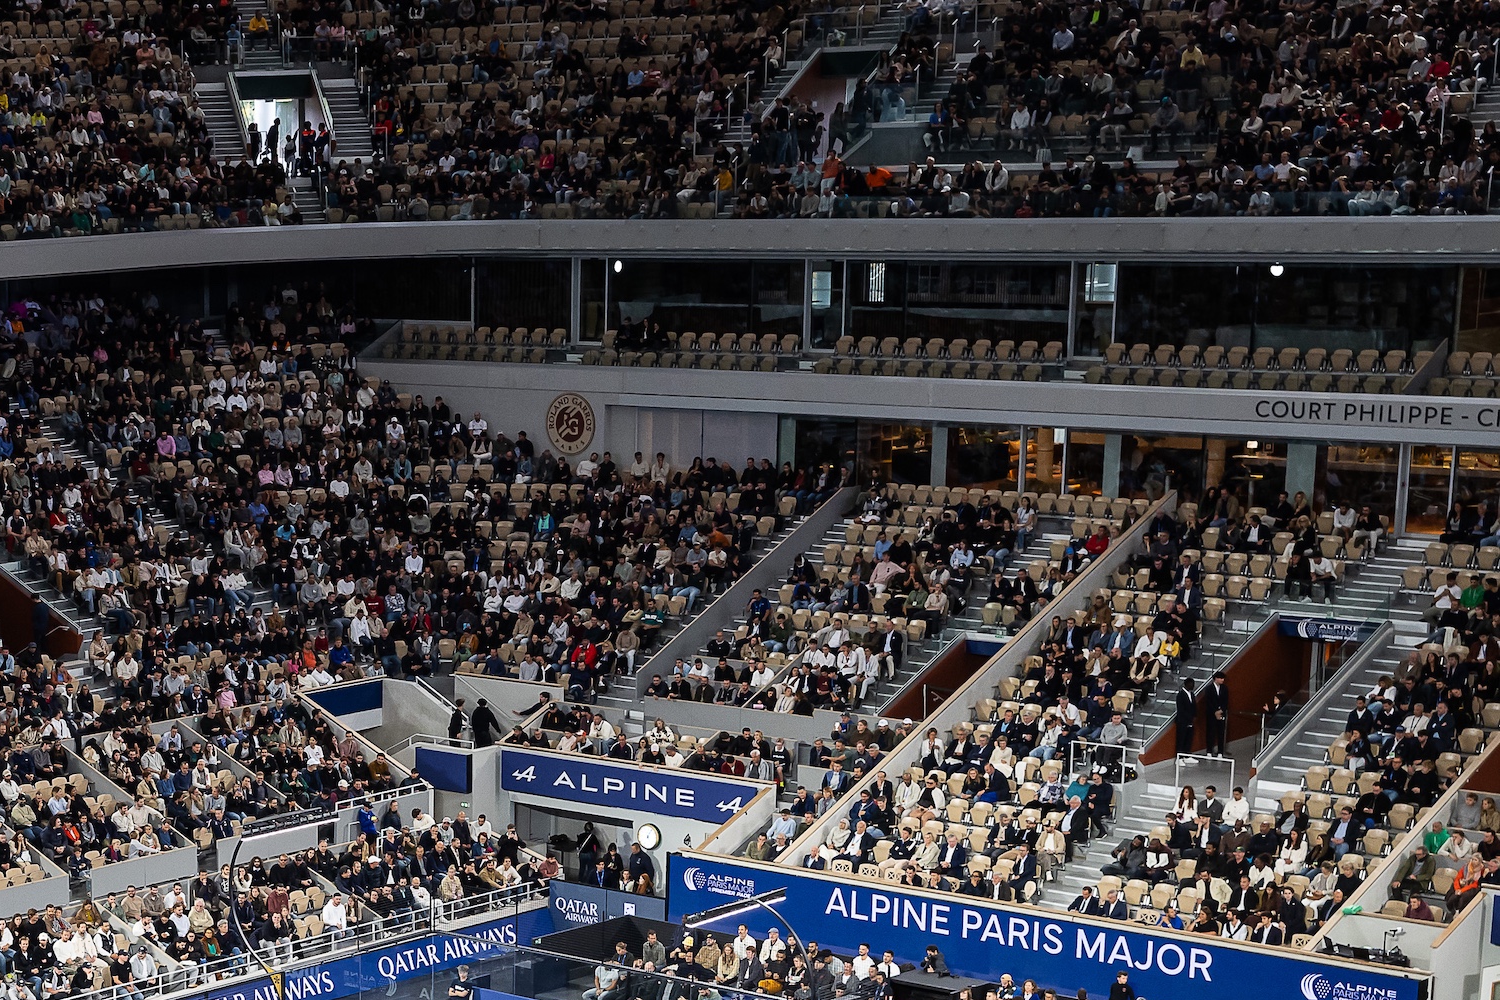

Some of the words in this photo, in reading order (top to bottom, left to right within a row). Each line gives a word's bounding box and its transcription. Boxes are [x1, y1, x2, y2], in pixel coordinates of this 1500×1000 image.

[548, 396, 569, 430] ROLAND
[571, 397, 593, 432] GARROS
[1255, 400, 1336, 420] COURT
[1343, 403, 1453, 425] PHILIPPE
[1477, 408, 1500, 427] C
[553, 770, 695, 807] ALPINE
[707, 879, 728, 890] PARIS
[728, 882, 754, 895] MAJOR
[708, 873, 755, 887] ALPINE
[736, 891, 752, 899] PADE
[555, 896, 599, 917] QATAR
[565, 911, 599, 925] AIRWAYS
[824, 886, 951, 936] ALPINE
[961, 908, 1063, 955] PARIS
[1075, 927, 1213, 982] MAJOR
[378, 944, 441, 980] QATAR
[444, 923, 517, 962] AIRWAYS
[1333, 981, 1397, 999] ALPINE
[1333, 987, 1360, 1000] PARIS
